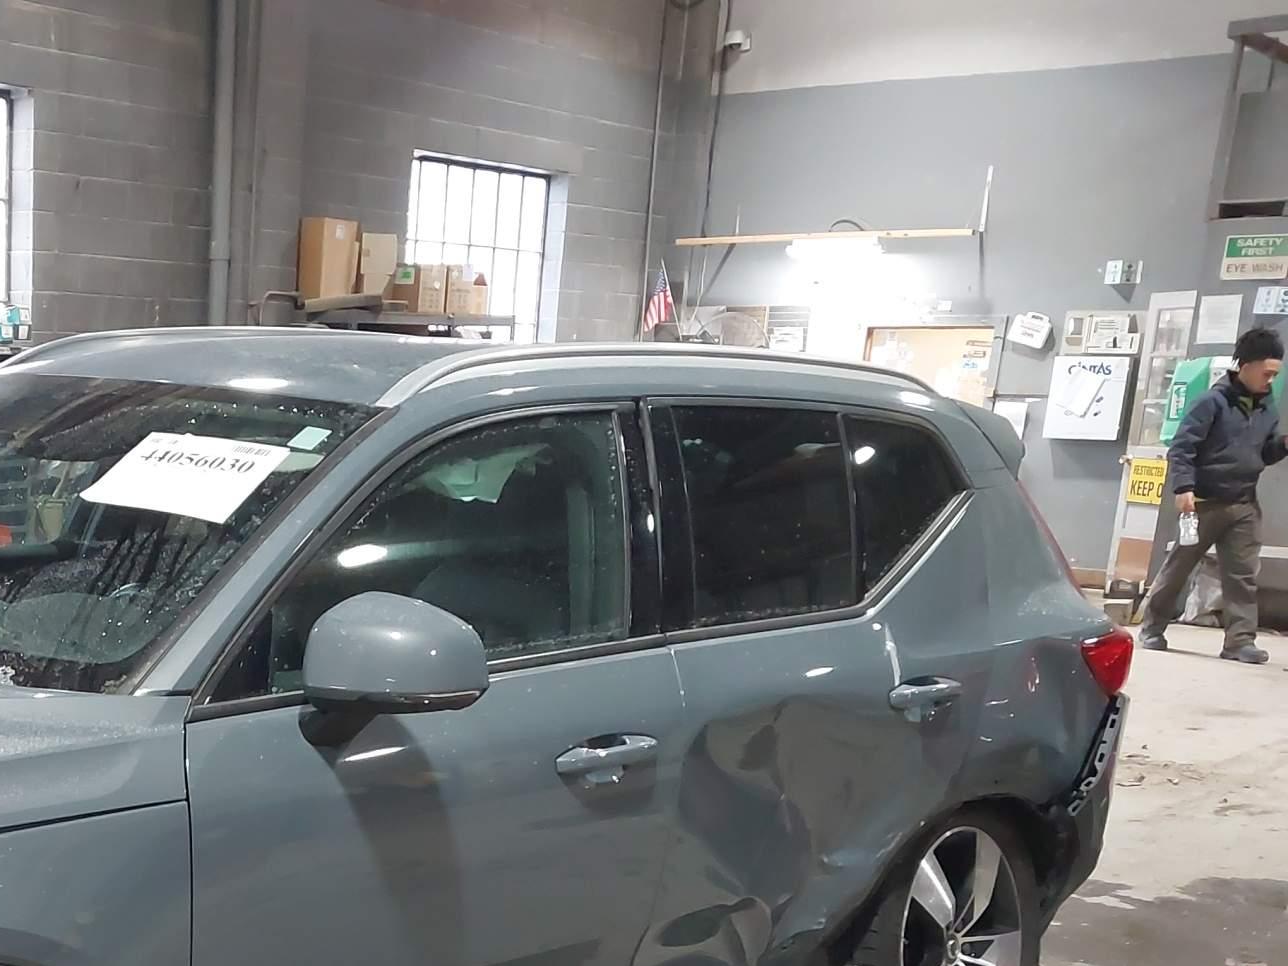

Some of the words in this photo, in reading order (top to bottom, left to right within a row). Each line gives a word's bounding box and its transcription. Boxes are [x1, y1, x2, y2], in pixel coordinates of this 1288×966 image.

[1237, 237, 1283, 247] SAFETY
[1241, 247, 1273, 256] FIRST
[1226, 263, 1247, 273] EYE
[139, 448, 256, 473] 44056030
[1130, 479, 1155, 497] KEEP
